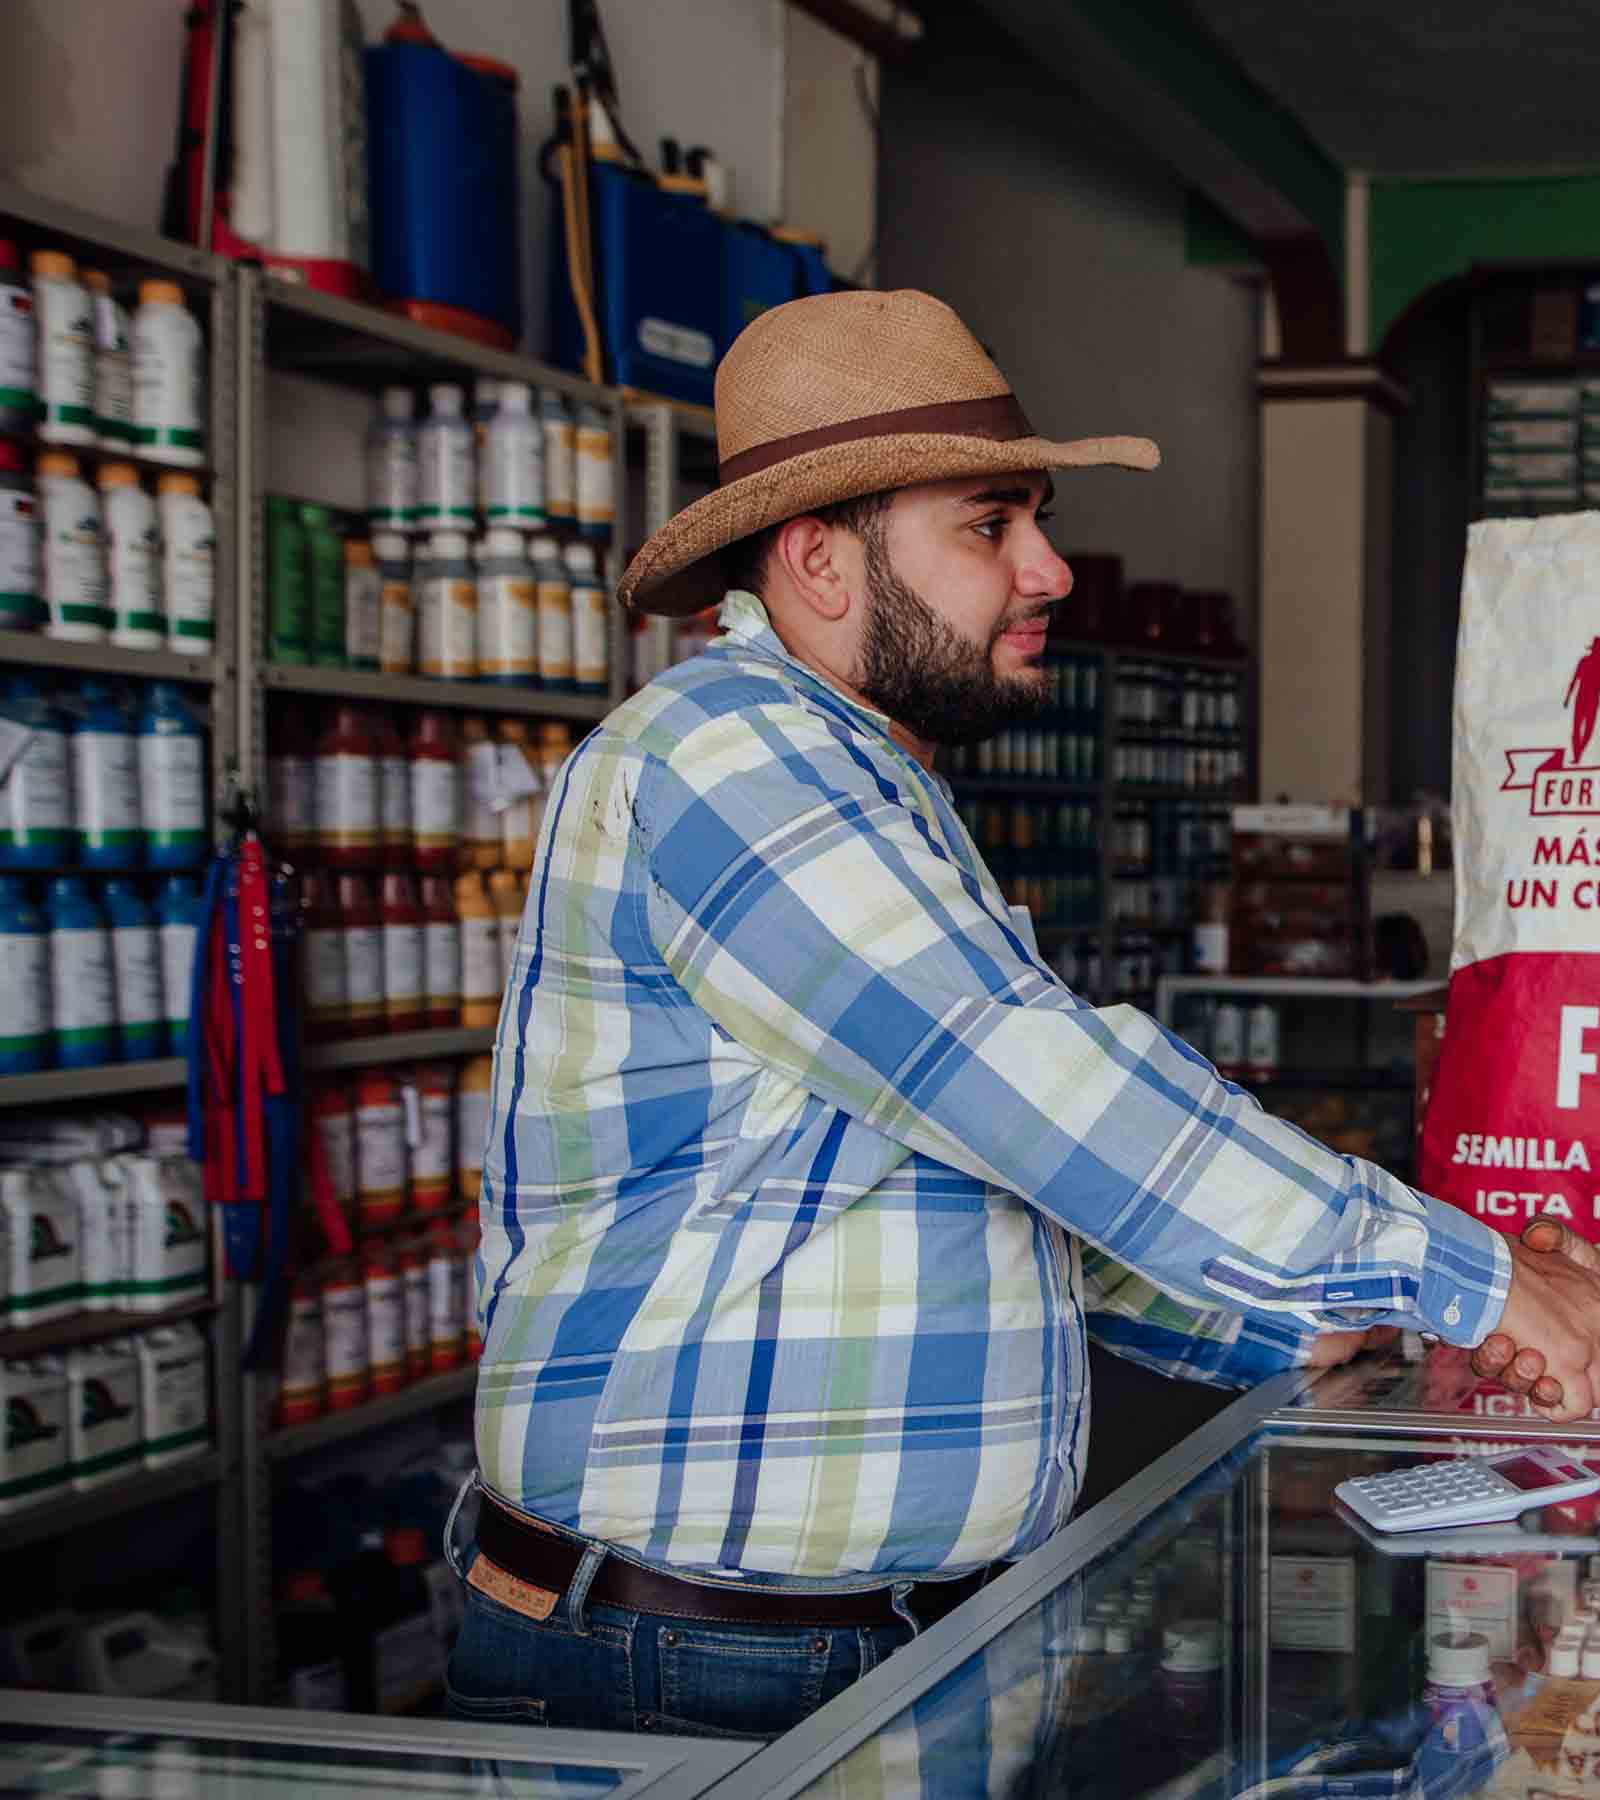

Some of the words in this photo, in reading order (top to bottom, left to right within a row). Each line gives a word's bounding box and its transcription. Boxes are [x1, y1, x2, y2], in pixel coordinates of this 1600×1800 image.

[1506, 878, 1559, 909] UN
[1451, 1133, 1591, 1173] SEMILLA
[1475, 1190, 1572, 1218] ICTA
